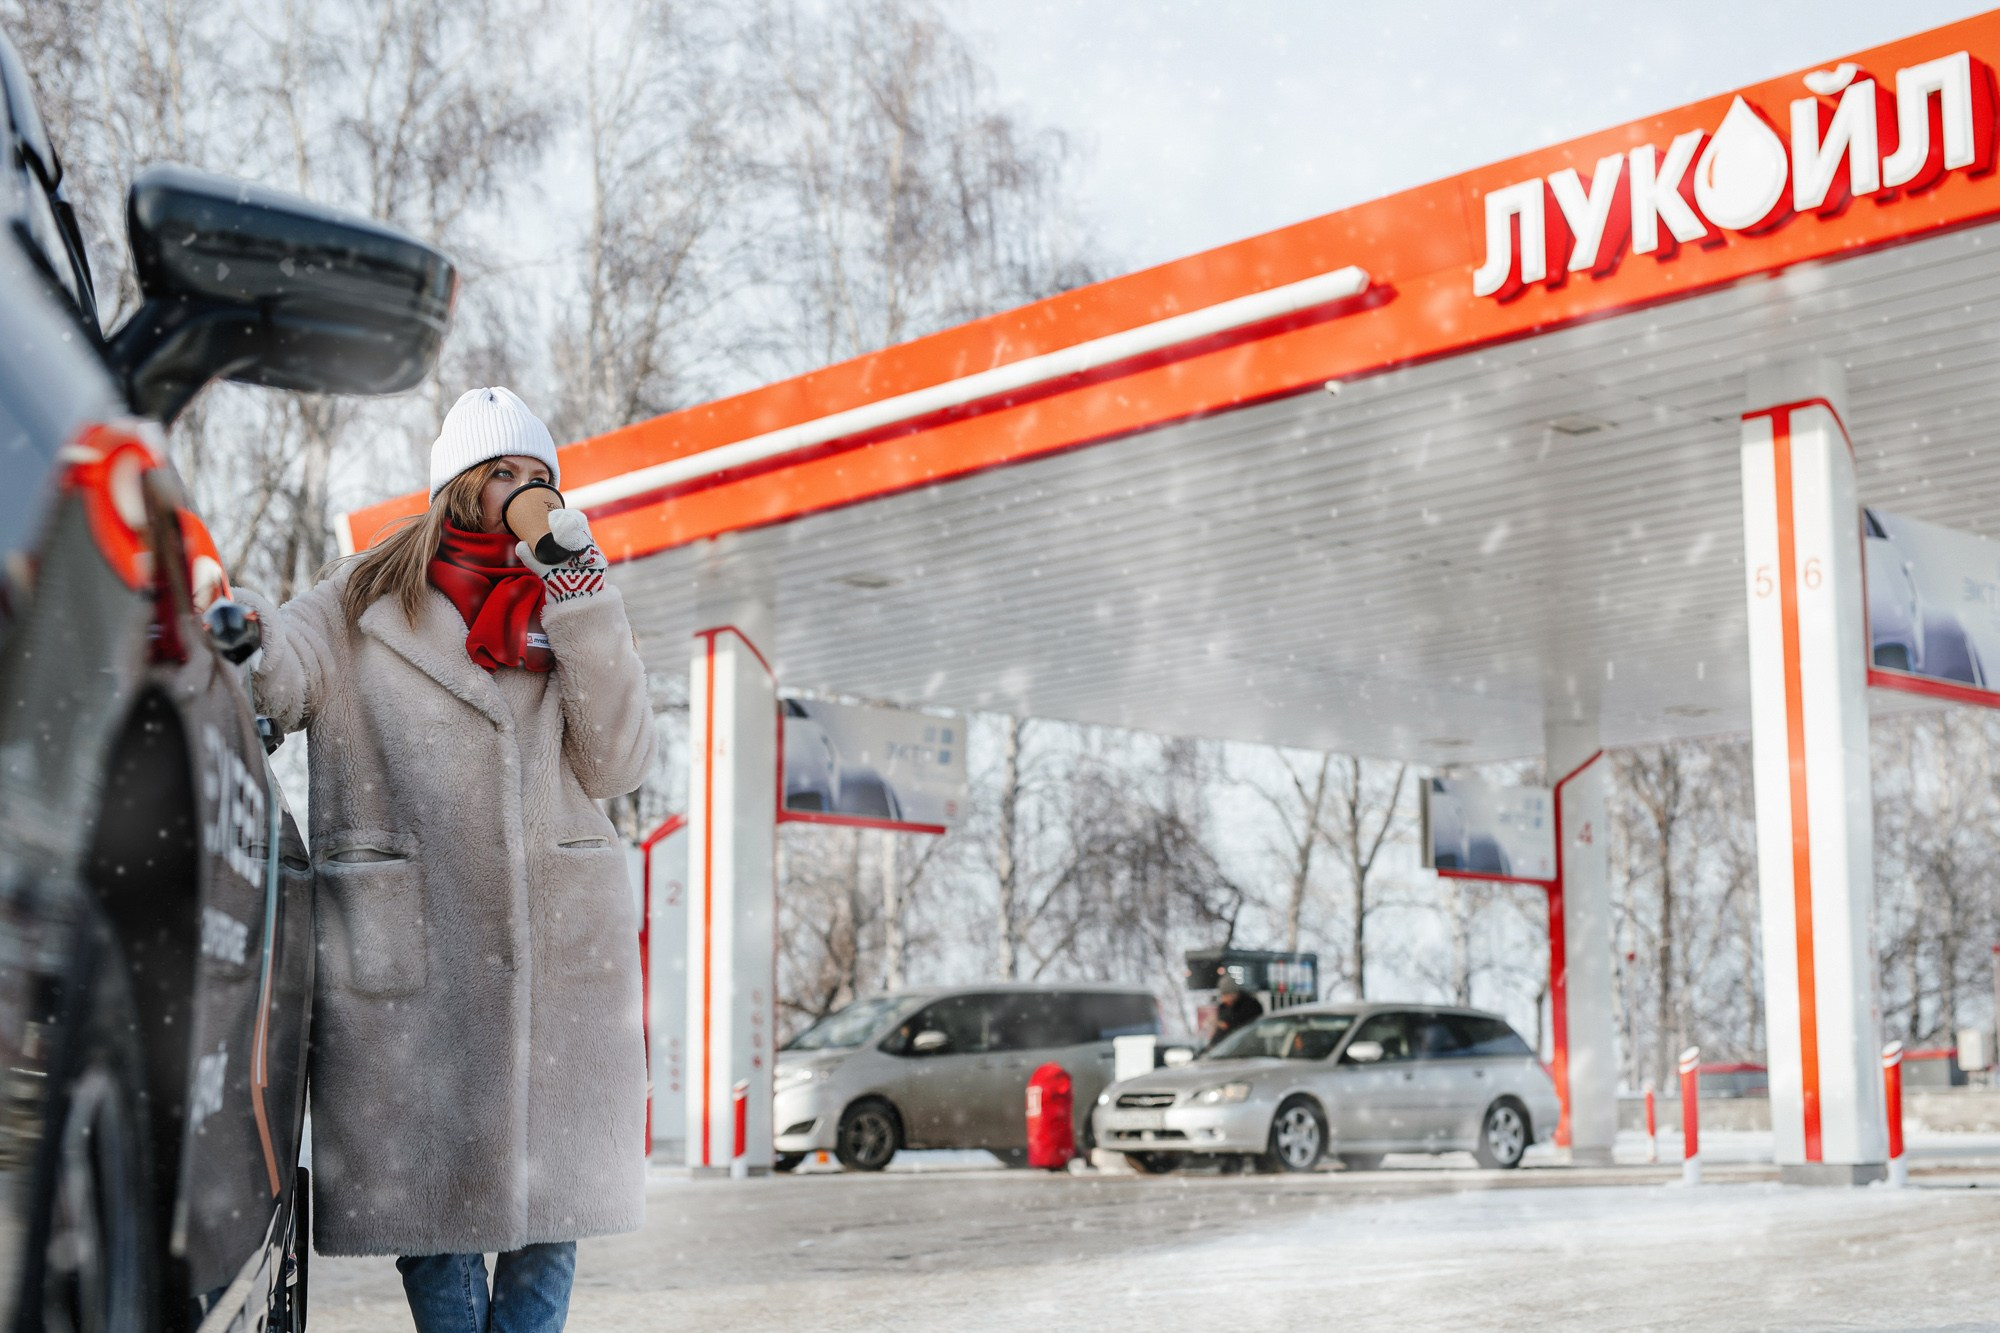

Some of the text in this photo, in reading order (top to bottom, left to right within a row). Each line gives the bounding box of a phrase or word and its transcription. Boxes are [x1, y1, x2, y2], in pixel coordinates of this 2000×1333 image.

[1755, 564, 1773, 599] 5
[1804, 556, 1823, 590] 6
[1578, 821, 1593, 845] 4
[665, 880, 684, 907] 2
